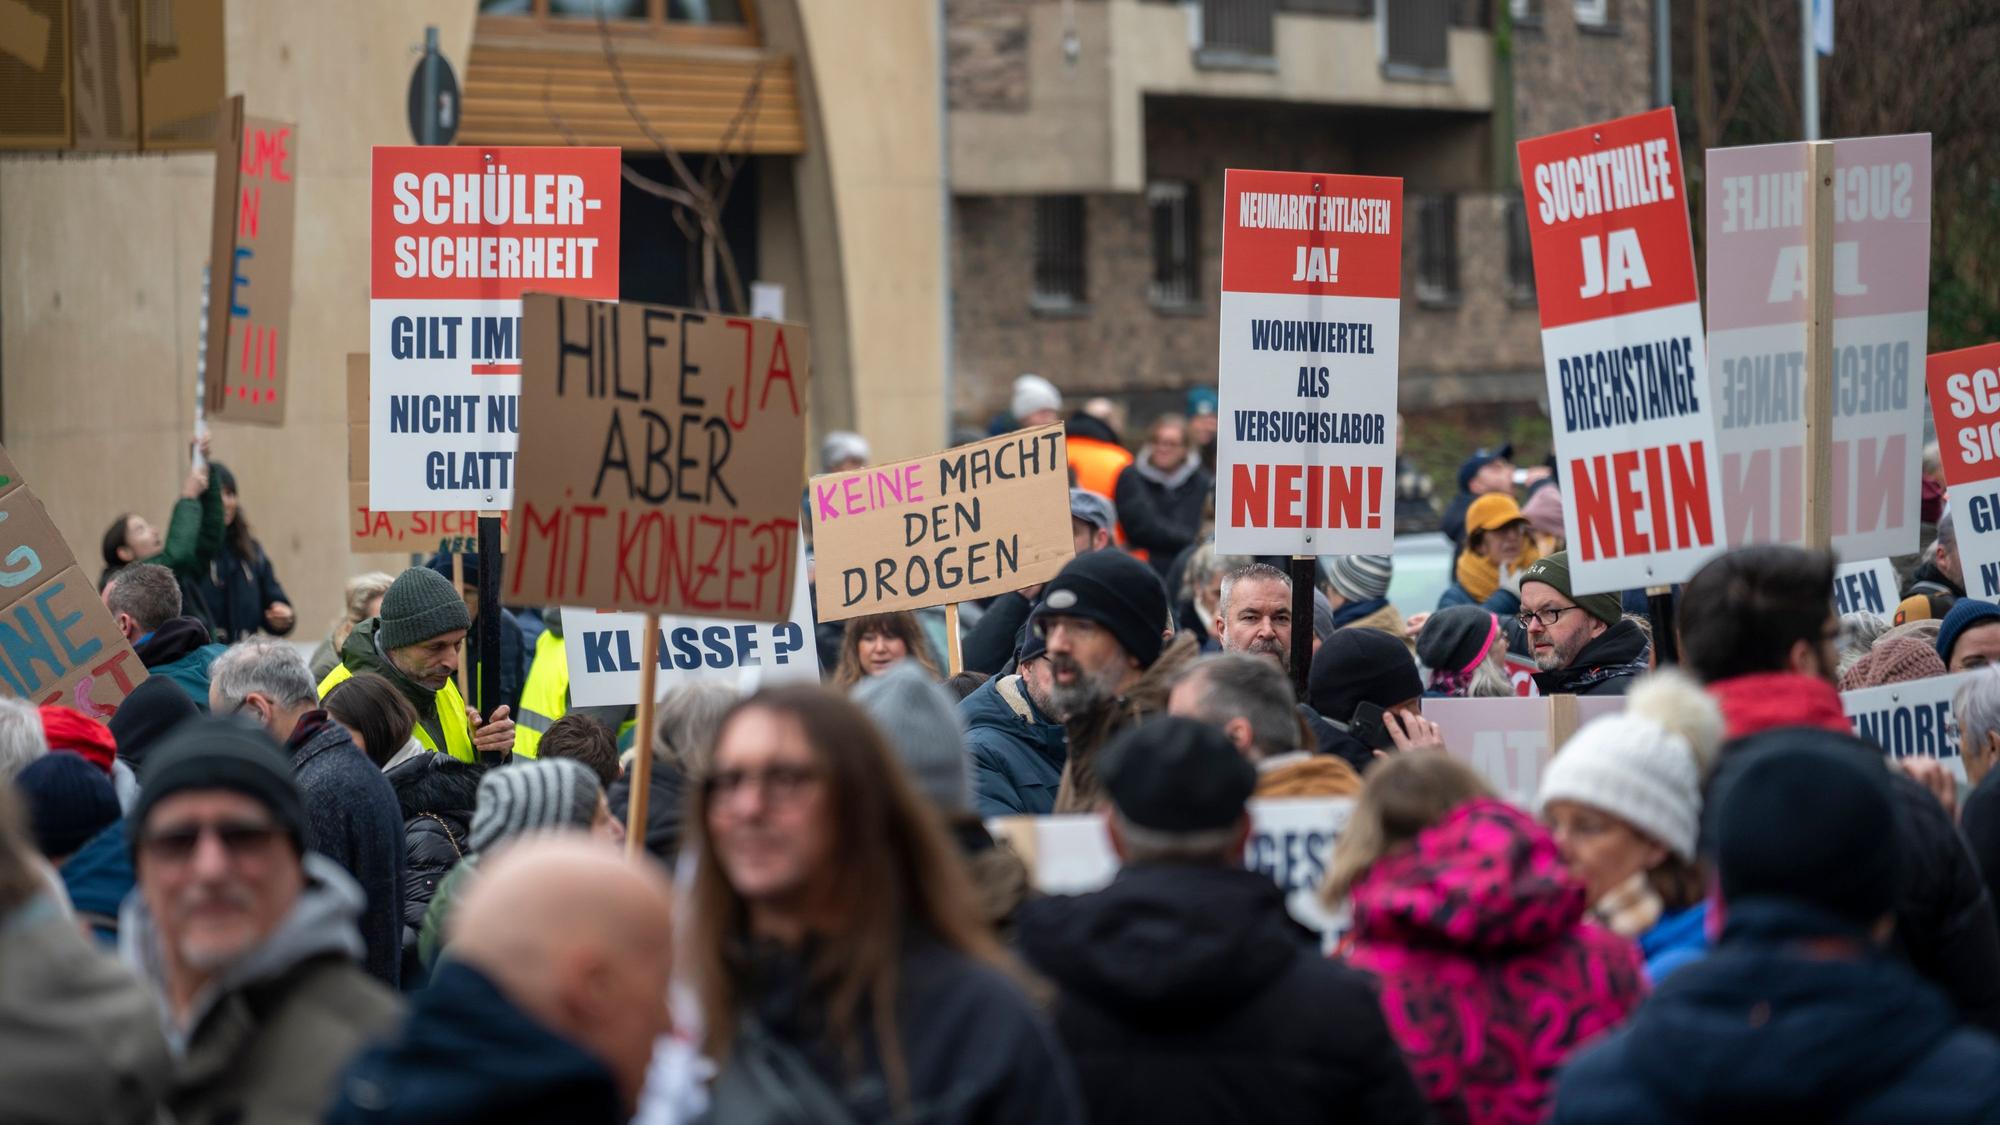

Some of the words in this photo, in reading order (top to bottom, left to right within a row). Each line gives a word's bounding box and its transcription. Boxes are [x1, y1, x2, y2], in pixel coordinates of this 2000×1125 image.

[393, 165, 601, 225] SCHÜLER-
[1535, 138, 1675, 225] SUCHTHILFE
[1240, 192, 1316, 231] NEUMARKT
[1319, 197, 1391, 235] ENTLASTEN
[394, 236, 599, 279] SICHERHEIT
[1293, 246, 1339, 283] JA!
[1580, 227, 1652, 299] JA
[390, 316, 463, 360] GILT
[471, 317, 523, 359] IM
[1251, 319, 1374, 354] WOHNVIERTEL
[726, 320, 800, 431] JA
[1297, 366, 1330, 398] ALS
[1558, 336, 1700, 433] BRECHSTANGE
[1946, 367, 2000, 419] SC
[390, 394, 481, 433] NICHT
[1234, 410, 1385, 444] VERSUCHSLABOR
[426, 451, 516, 490] GLATT
[592, 407, 738, 509] ABER
[817, 464, 924, 522] KEINE
[939, 431, 1063, 497] MACHT
[903, 497, 981, 547] DEN
[1231, 464, 1383, 529] NEIN!
[1571, 440, 1714, 562] NEIN
[612, 508, 798, 614] KONZEPT
[842, 534, 1018, 607] DROGEN
[583, 624, 762, 673] KLASSE
[772, 621, 804, 664] ?
